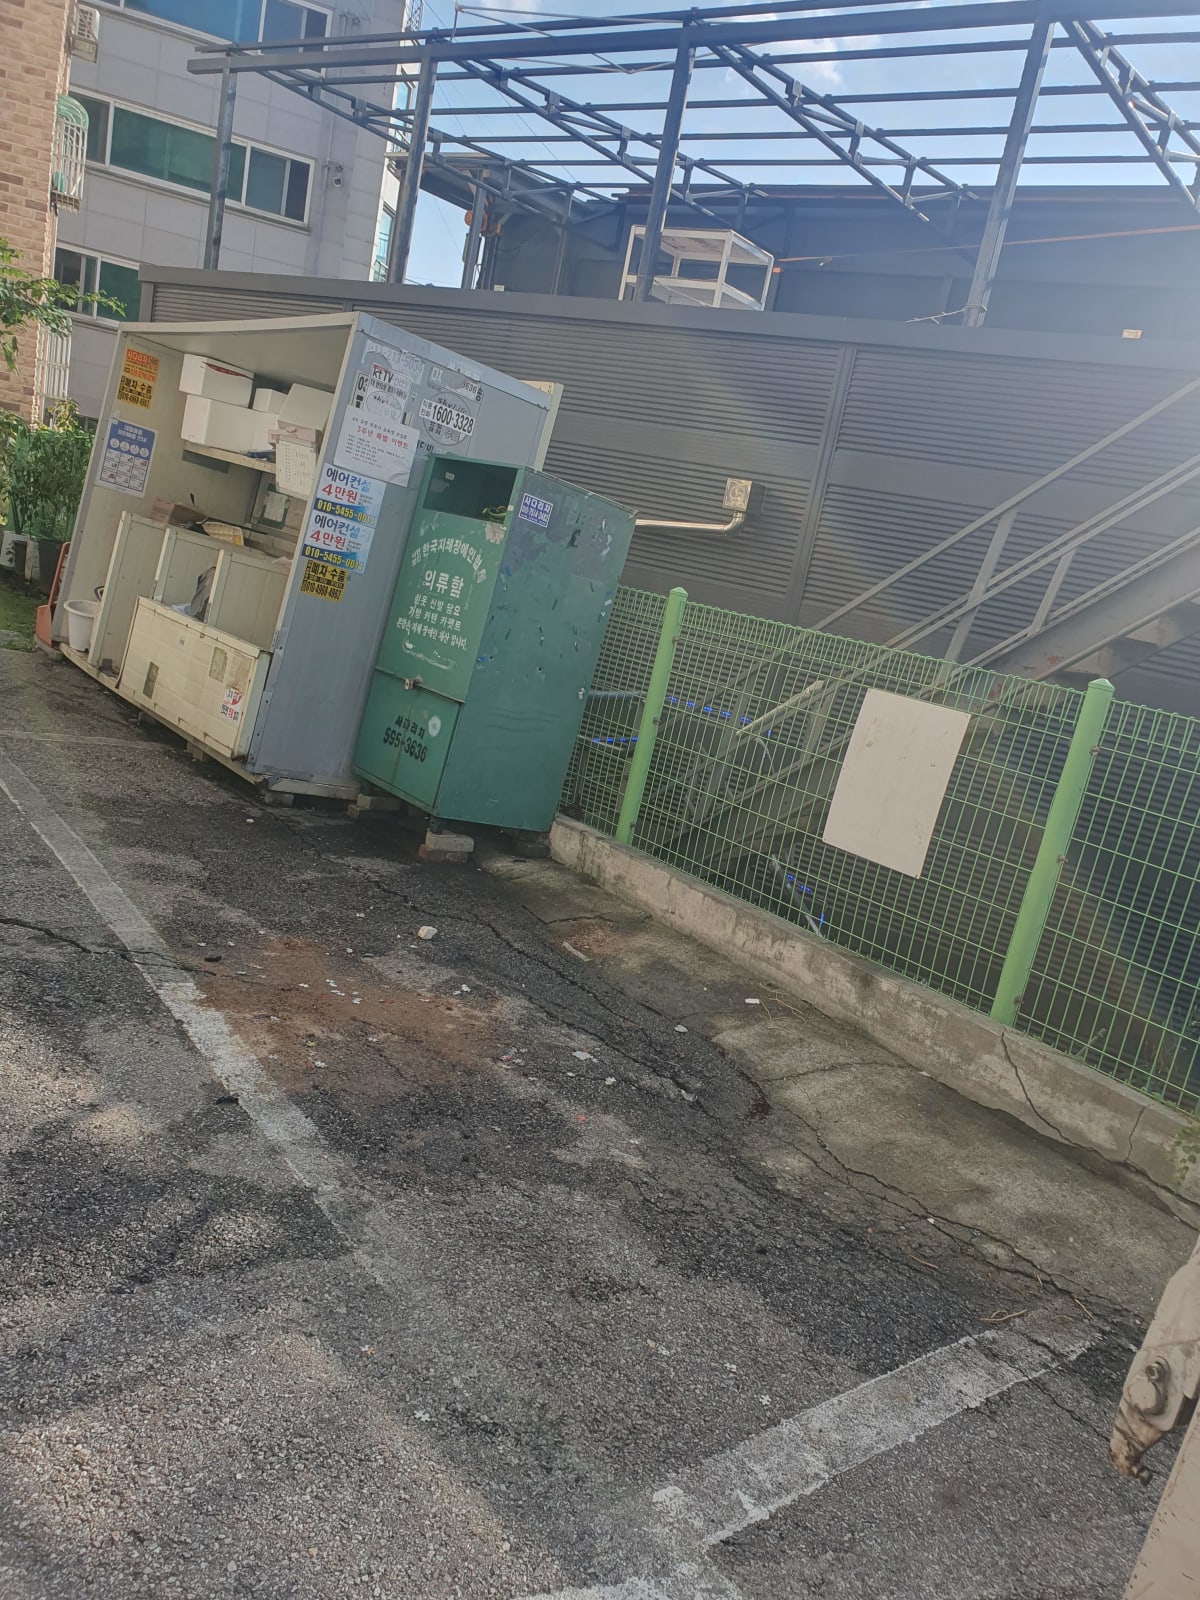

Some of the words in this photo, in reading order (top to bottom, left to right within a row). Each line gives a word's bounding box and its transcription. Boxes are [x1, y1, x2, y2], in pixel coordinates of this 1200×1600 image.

[356, 425, 374, 438] 3주년
[391, 438, 409, 450] 이벤트
[322, 483, 357, 505] 4만원
[310, 529, 346, 550] 4만원
[423, 569, 465, 599] 의류함
[408, 605, 422, 619] 가방
[430, 598, 444, 612] 신발
[446, 602, 461, 617] 담요
[383, 726, 428, 763] 595-3636
